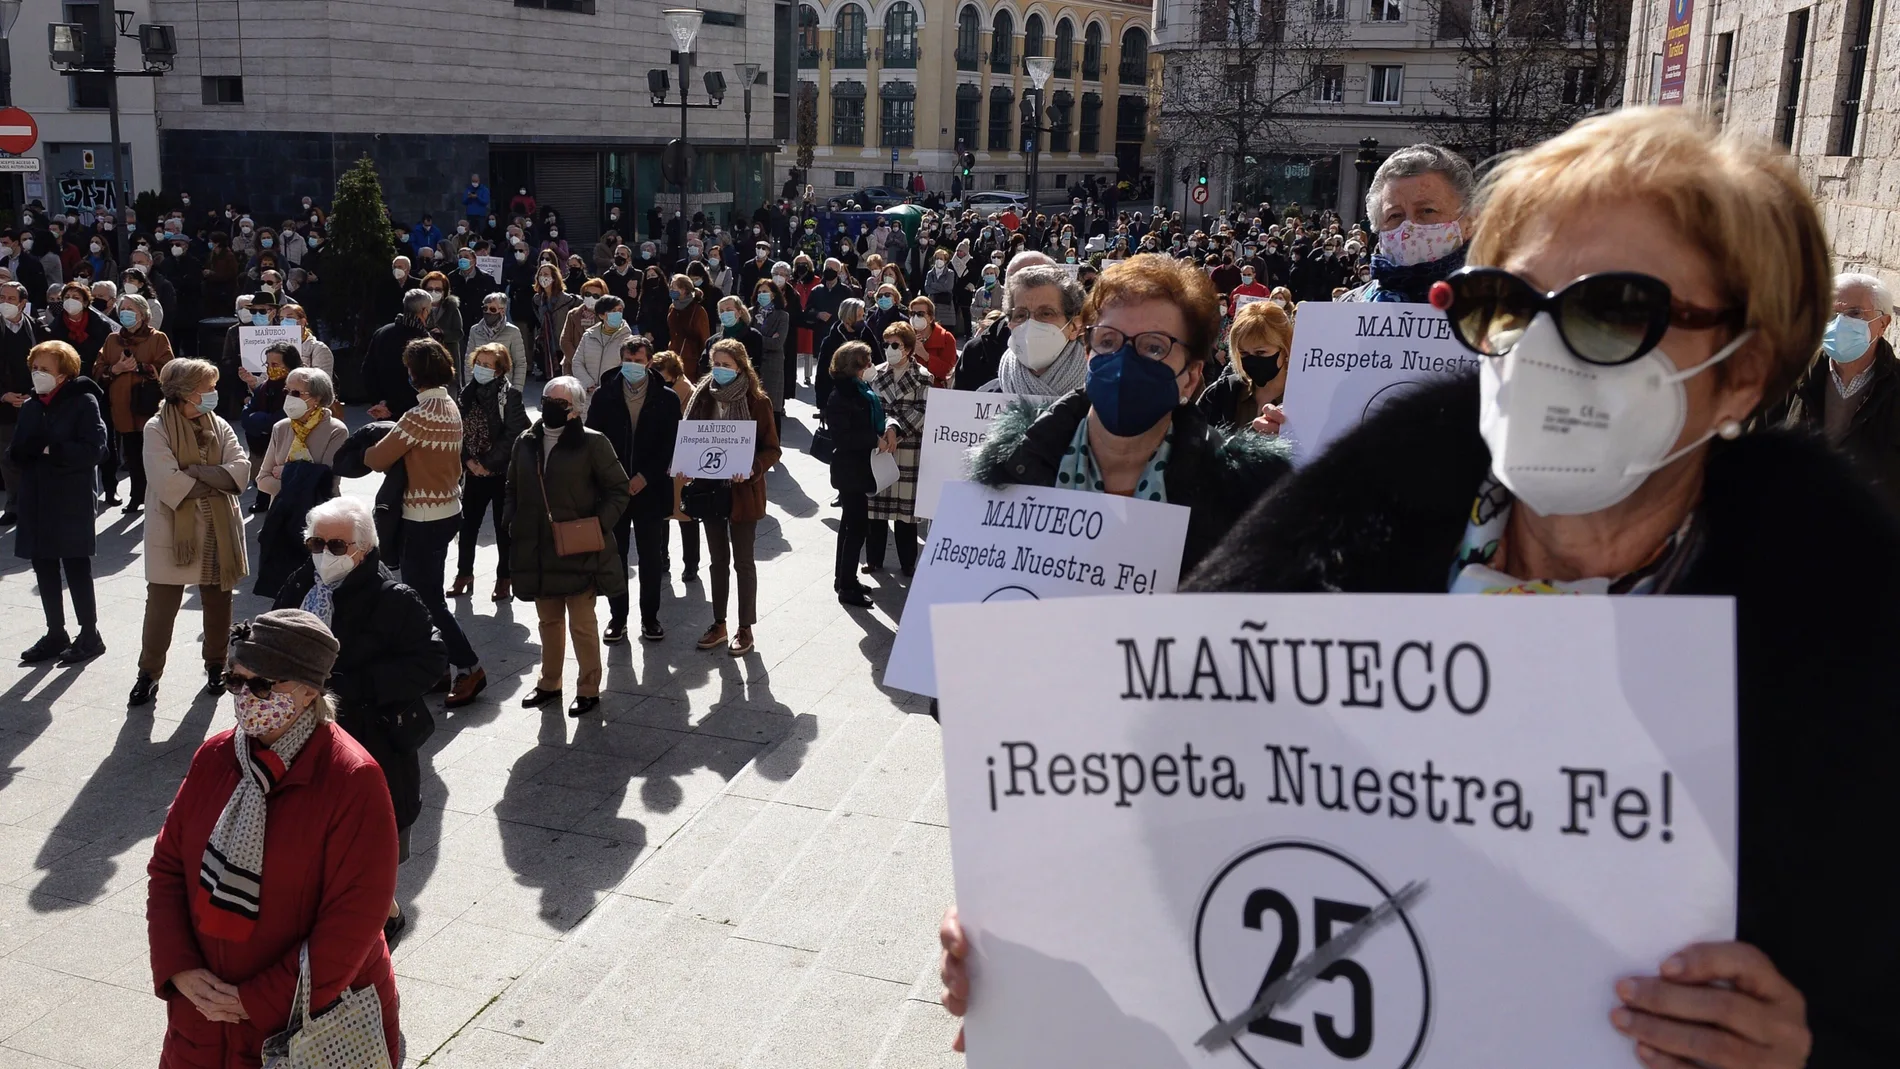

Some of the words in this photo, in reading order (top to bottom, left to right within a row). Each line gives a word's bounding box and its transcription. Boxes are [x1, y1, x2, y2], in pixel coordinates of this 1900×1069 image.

[255, 328, 286, 336] MAÑUECO
[1302, 348, 1393, 372] ¡Respeta
[680, 436, 710, 445] ¡Respeta
[711, 436, 739, 444] Nuestra
[740, 436, 751, 444] Fe!
[697, 422, 737, 433] MAÑUECO
[703, 452, 722, 469] 25
[981, 496, 1103, 540] MAÑUECO
[930, 537, 1006, 570] ¡Respeta
[1011, 546, 1106, 587] Nuestra
[1114, 563, 1157, 595] Fe!
[1115, 620, 1492, 716] MAÑUECO
[986, 741, 1246, 812] ¡Respeta
[1263, 743, 1533, 833] Nuestra
[1559, 766, 1675, 843] Fe!
[1243, 887, 1374, 1060] 25
